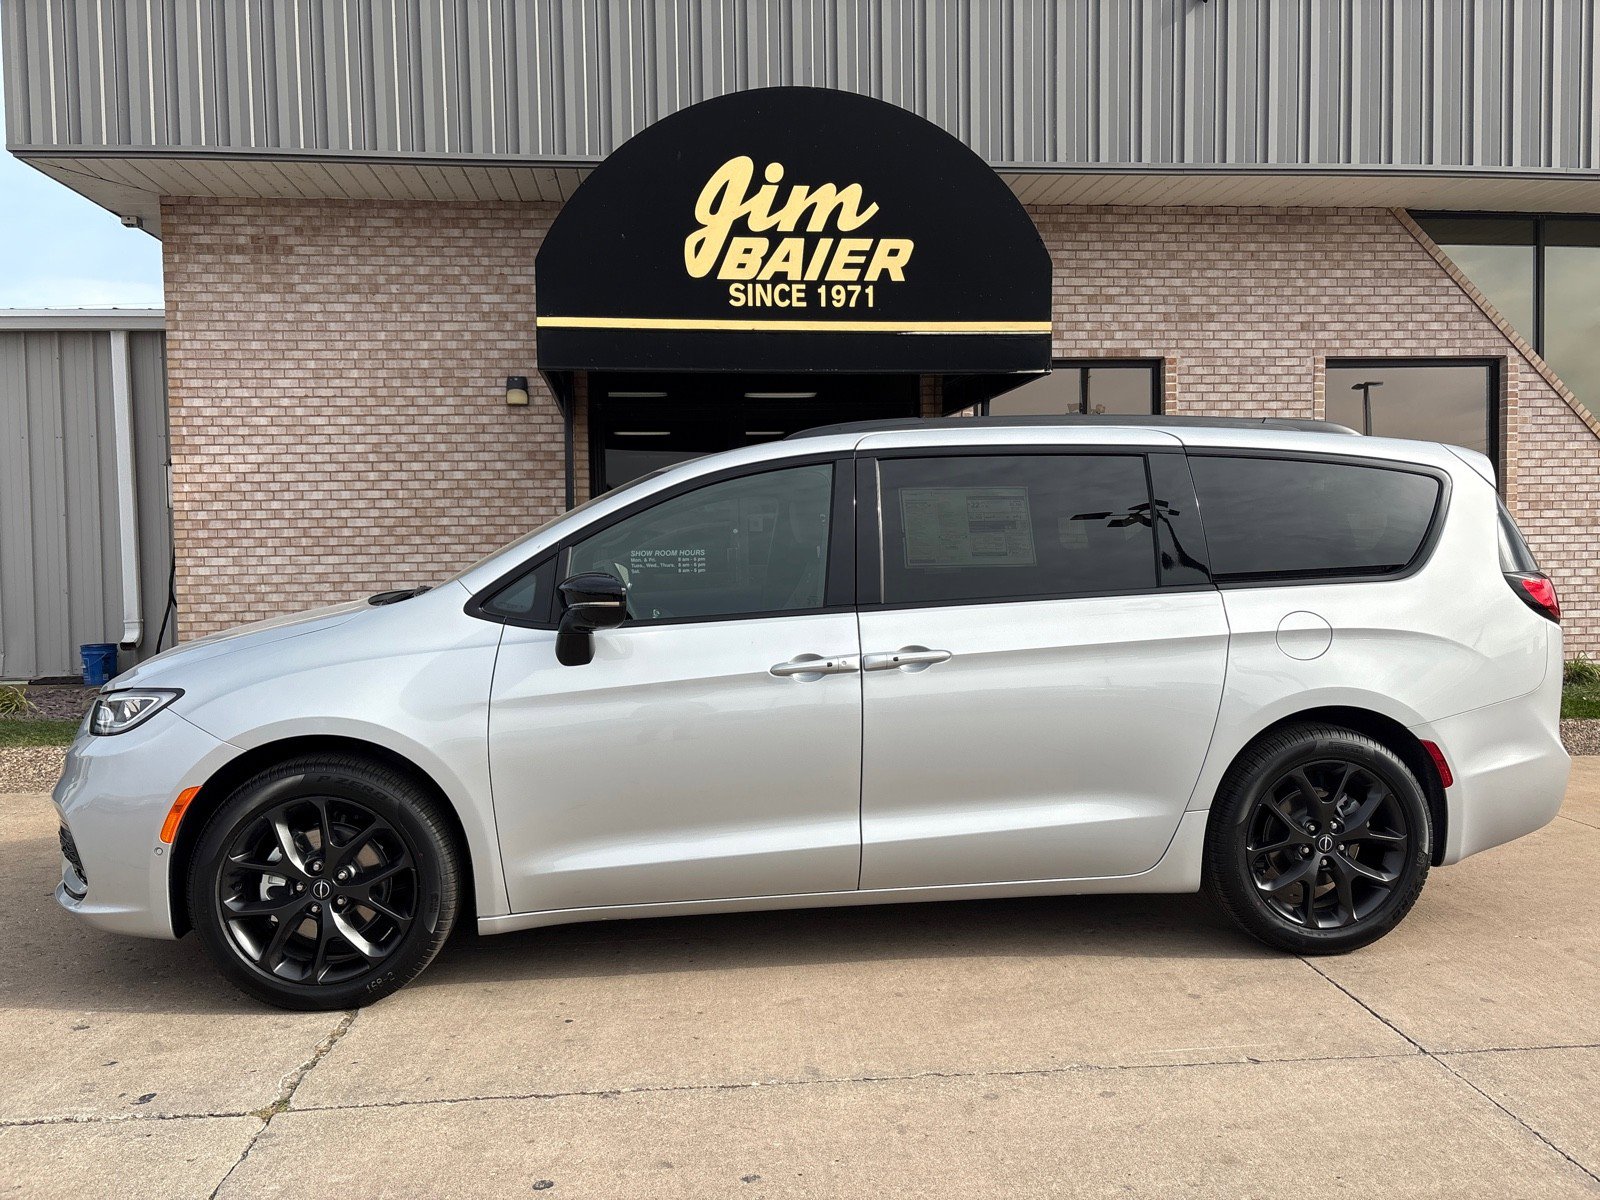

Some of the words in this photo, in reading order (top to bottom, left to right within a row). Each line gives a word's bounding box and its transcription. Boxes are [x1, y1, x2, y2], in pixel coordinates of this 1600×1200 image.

[684, 155, 880, 279] Jim
[716, 236, 915, 282] BAIER
[728, 282, 808, 308] SINCE
[817, 283, 875, 308] 1971
